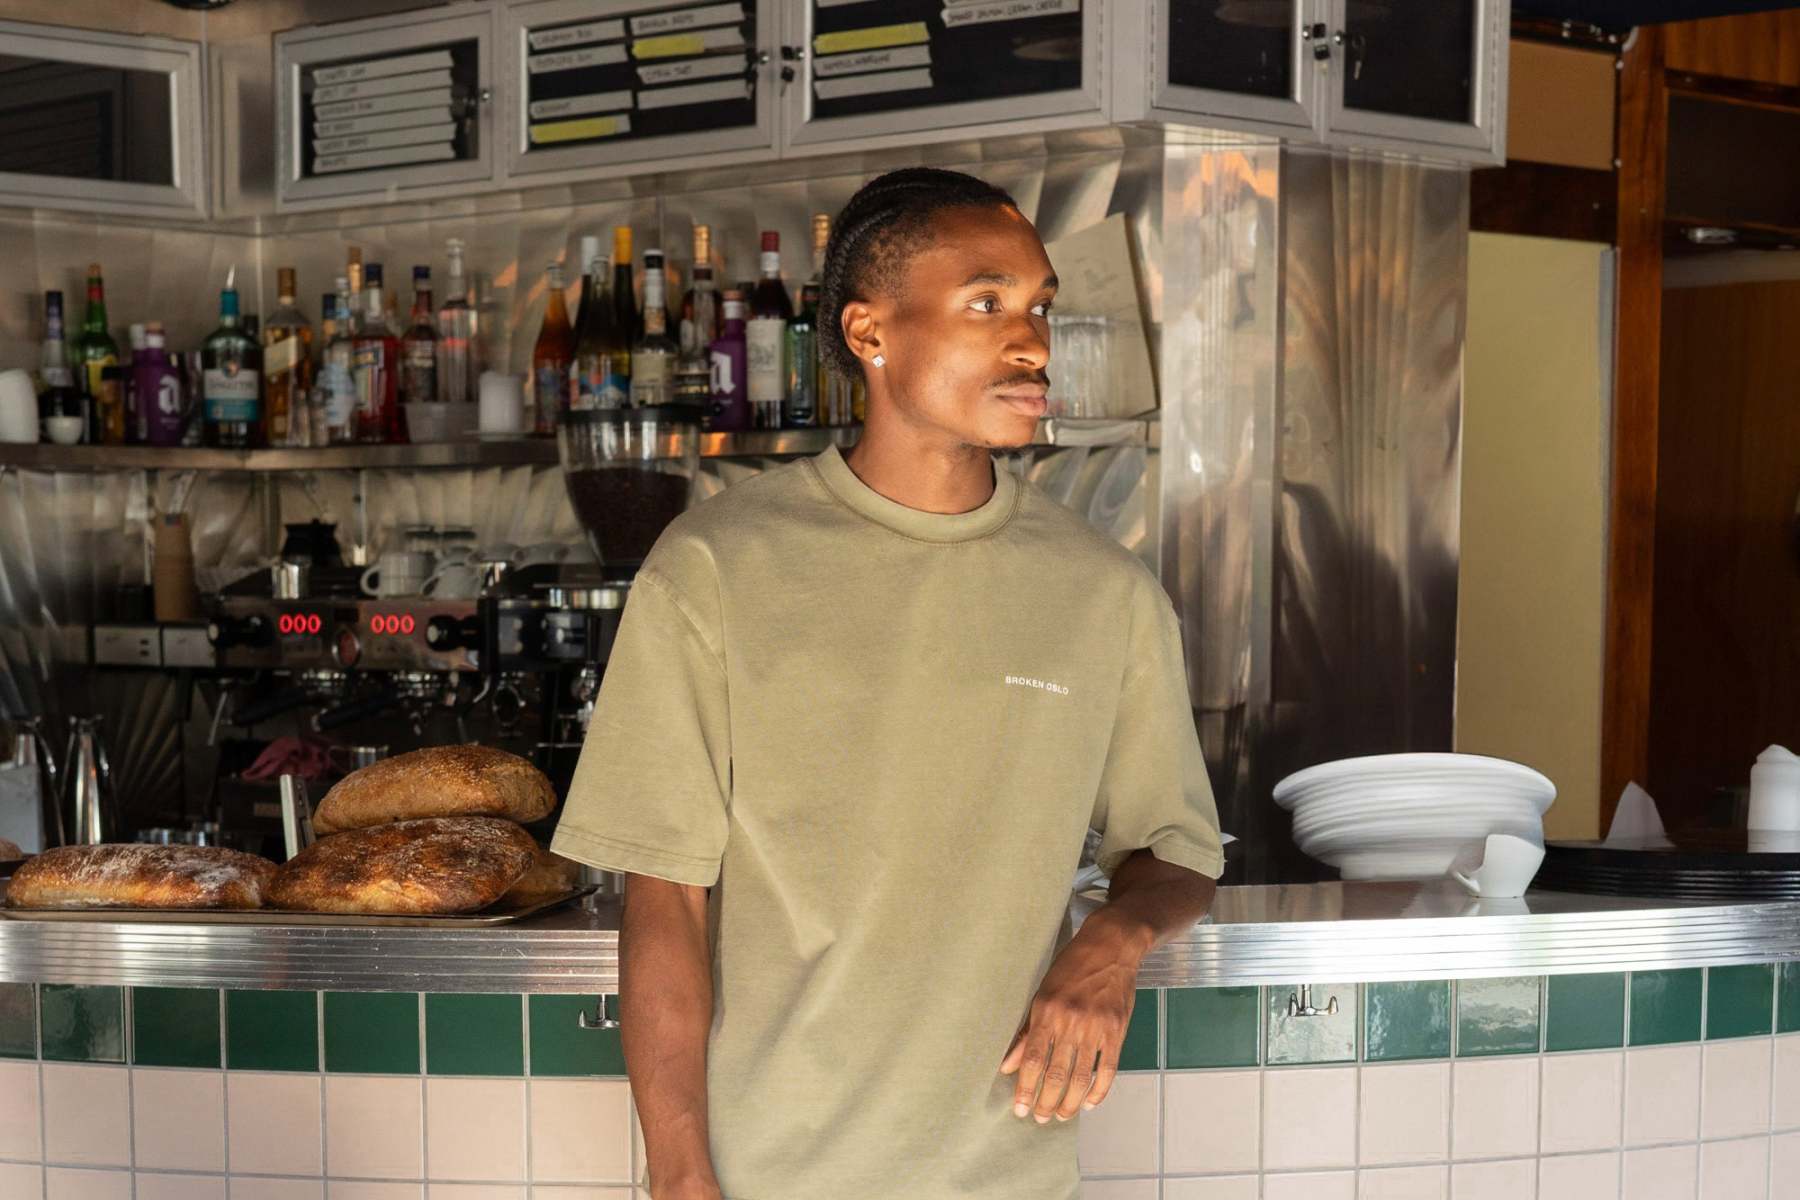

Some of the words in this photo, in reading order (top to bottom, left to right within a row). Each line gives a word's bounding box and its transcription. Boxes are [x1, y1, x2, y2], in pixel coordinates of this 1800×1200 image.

[279, 613, 321, 635] 000
[370, 613, 415, 635] 000
[1005, 675, 1044, 688] BROKEN
[1046, 682, 1069, 695] OSLO
